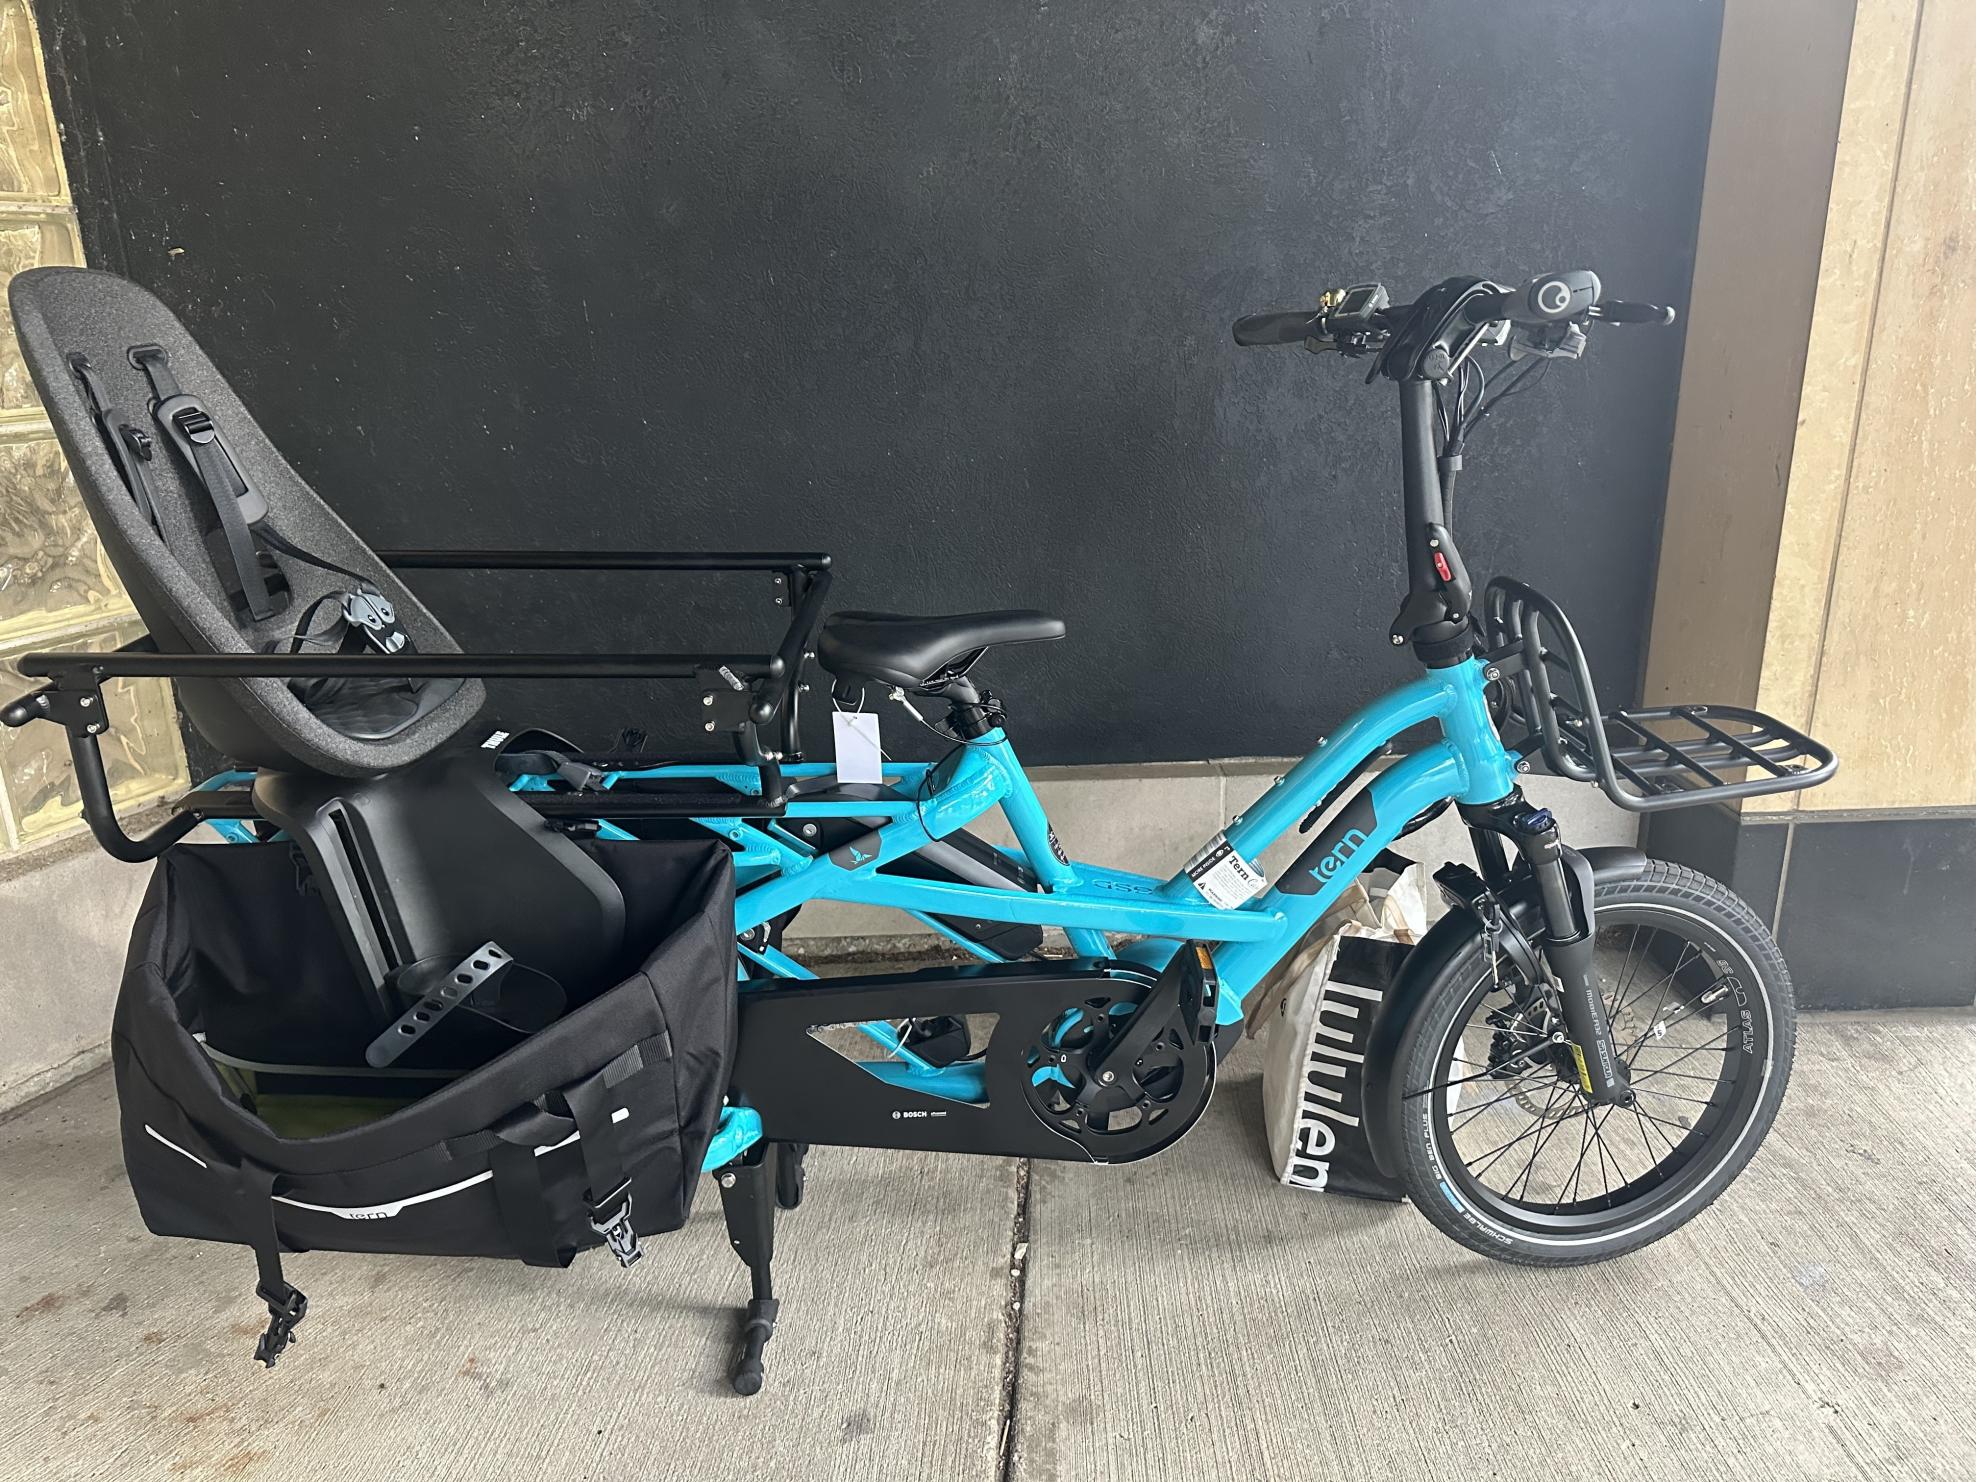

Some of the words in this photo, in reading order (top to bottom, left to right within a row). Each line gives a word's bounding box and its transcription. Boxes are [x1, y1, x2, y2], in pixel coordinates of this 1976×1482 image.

[1228, 855, 1251, 881] Tern
[1308, 828, 1368, 883] tern
[1740, 1009, 1754, 1055] ATLAS
[902, 1110, 928, 1118] BOSCH
[1421, 1112, 1430, 1140] PLUS
[1431, 1165, 1443, 1181] BIG
[1462, 1212, 1514, 1246] SCHWALBE
